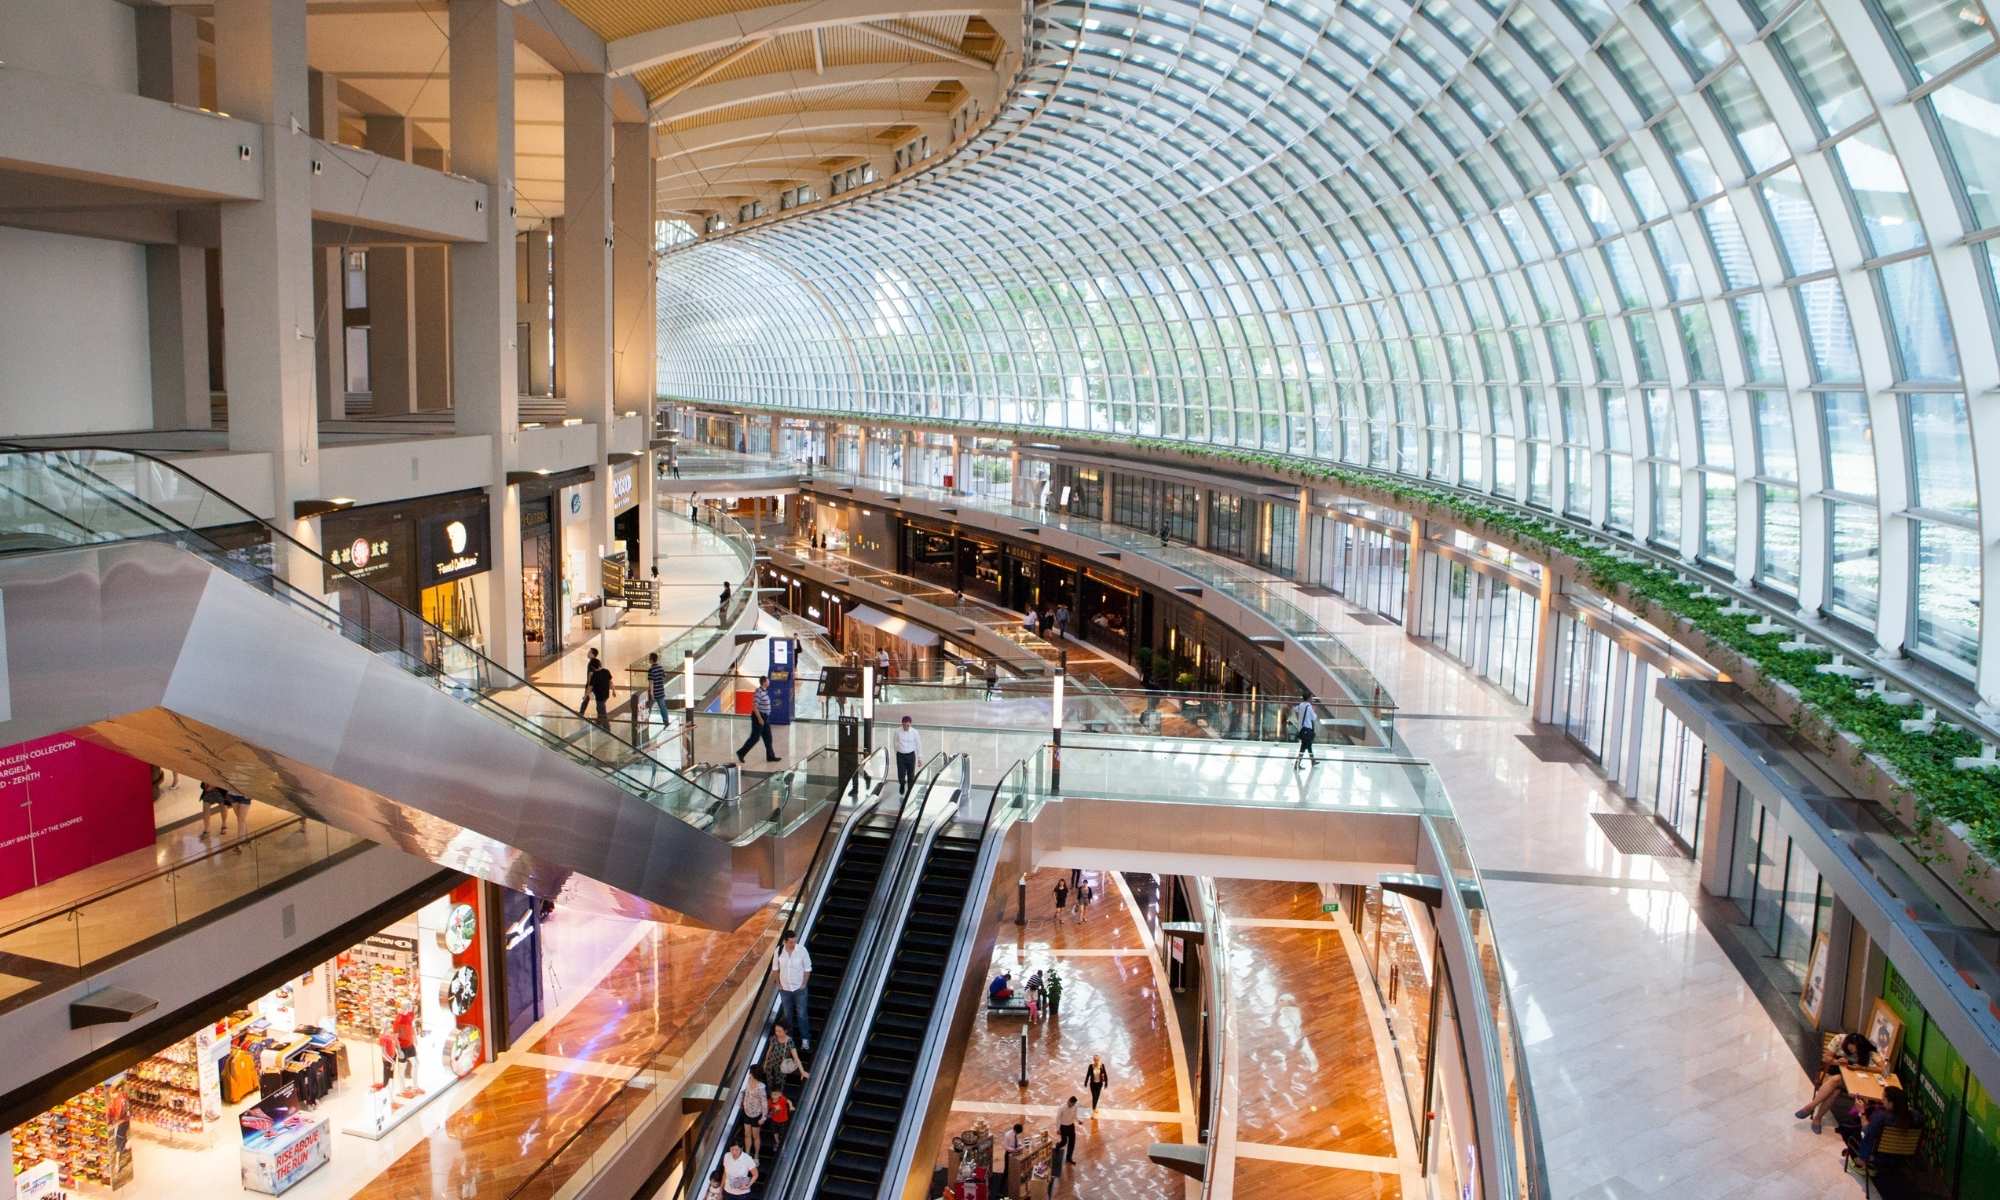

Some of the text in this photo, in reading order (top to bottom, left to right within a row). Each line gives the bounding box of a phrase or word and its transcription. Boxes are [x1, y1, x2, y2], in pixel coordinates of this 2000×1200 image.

[845, 725, 850, 736] 1
[6, 753, 29, 765] KLEIN
[30, 740, 76, 759] COLLECTION
[13, 771, 40, 785] ZENITH
[48, 823, 60, 832] THE
[277, 1129, 321, 1168] RISE ABOVE
[276, 1163, 292, 1180] THE
[292, 1151, 309, 1174] RUN
